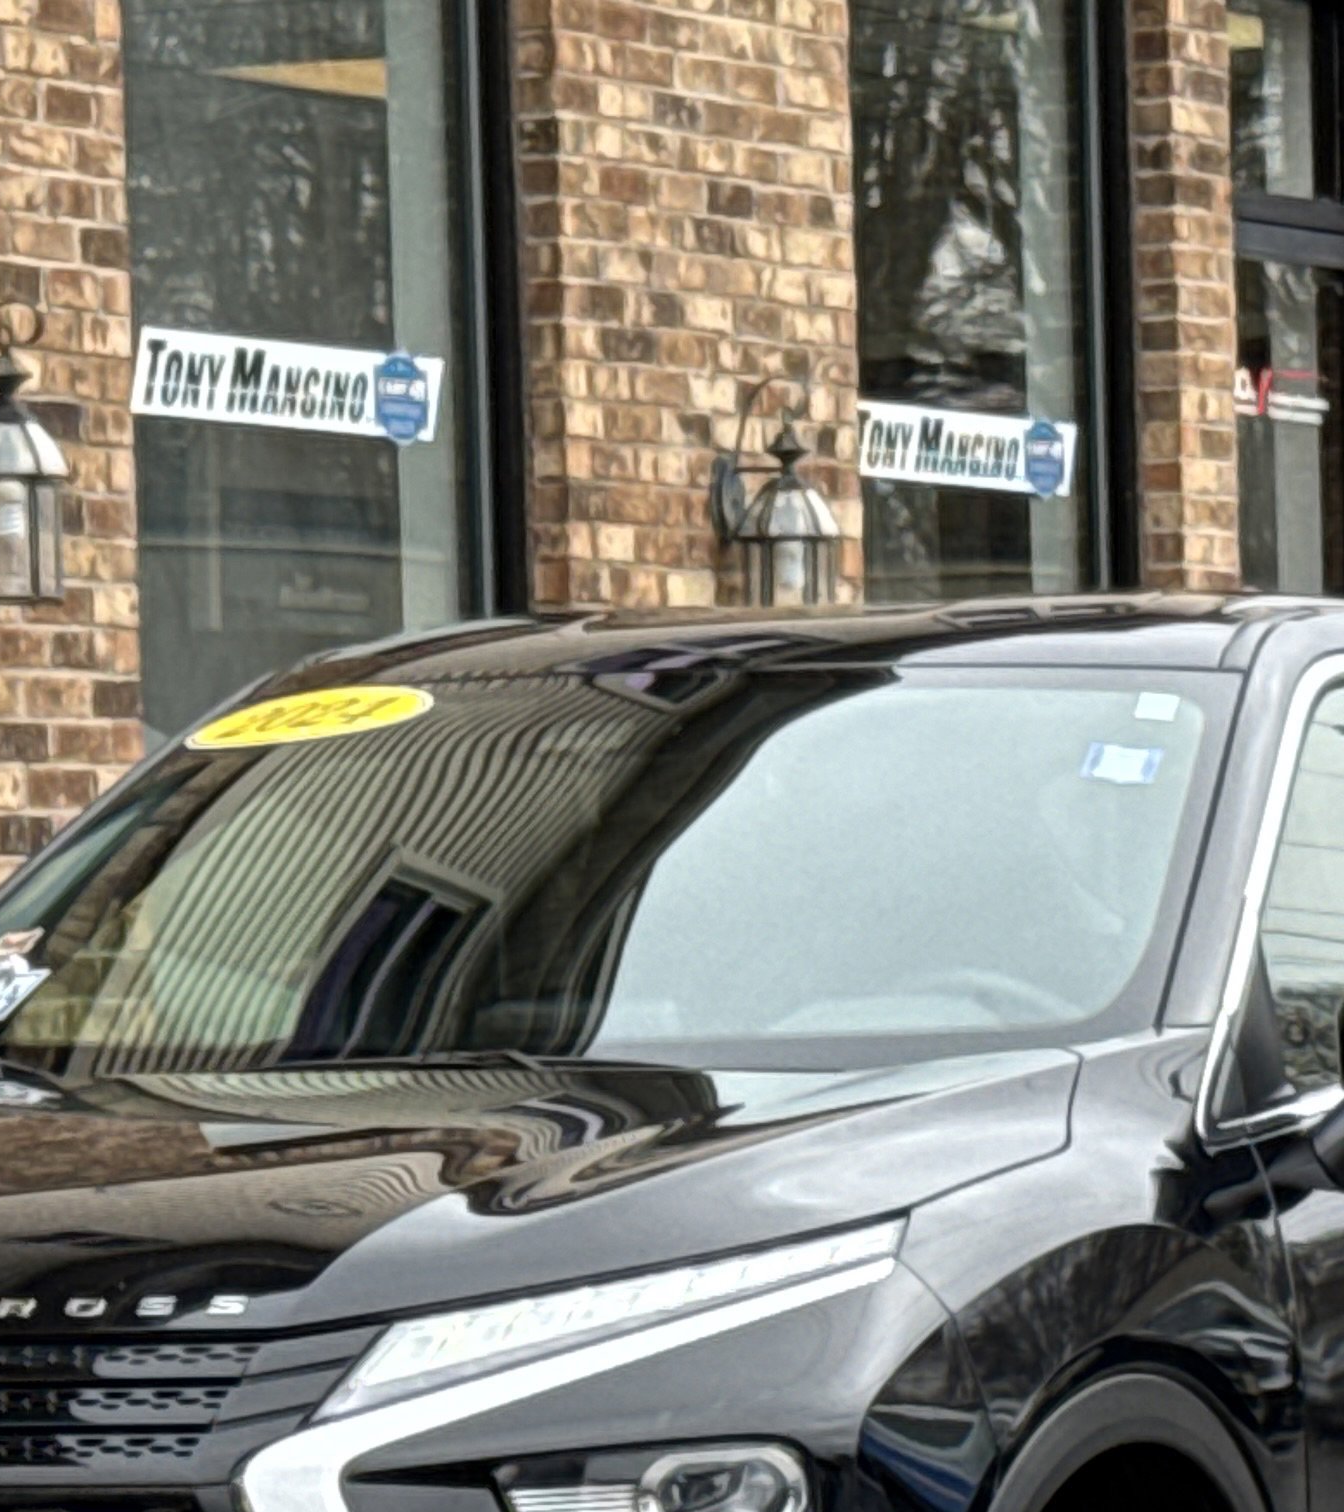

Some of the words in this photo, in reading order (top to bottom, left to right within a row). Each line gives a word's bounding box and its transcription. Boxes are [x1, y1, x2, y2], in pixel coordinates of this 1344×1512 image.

[143, 337, 226, 411] TONY
[225, 346, 369, 424] MANGINO
[857, 410, 914, 470] TONY
